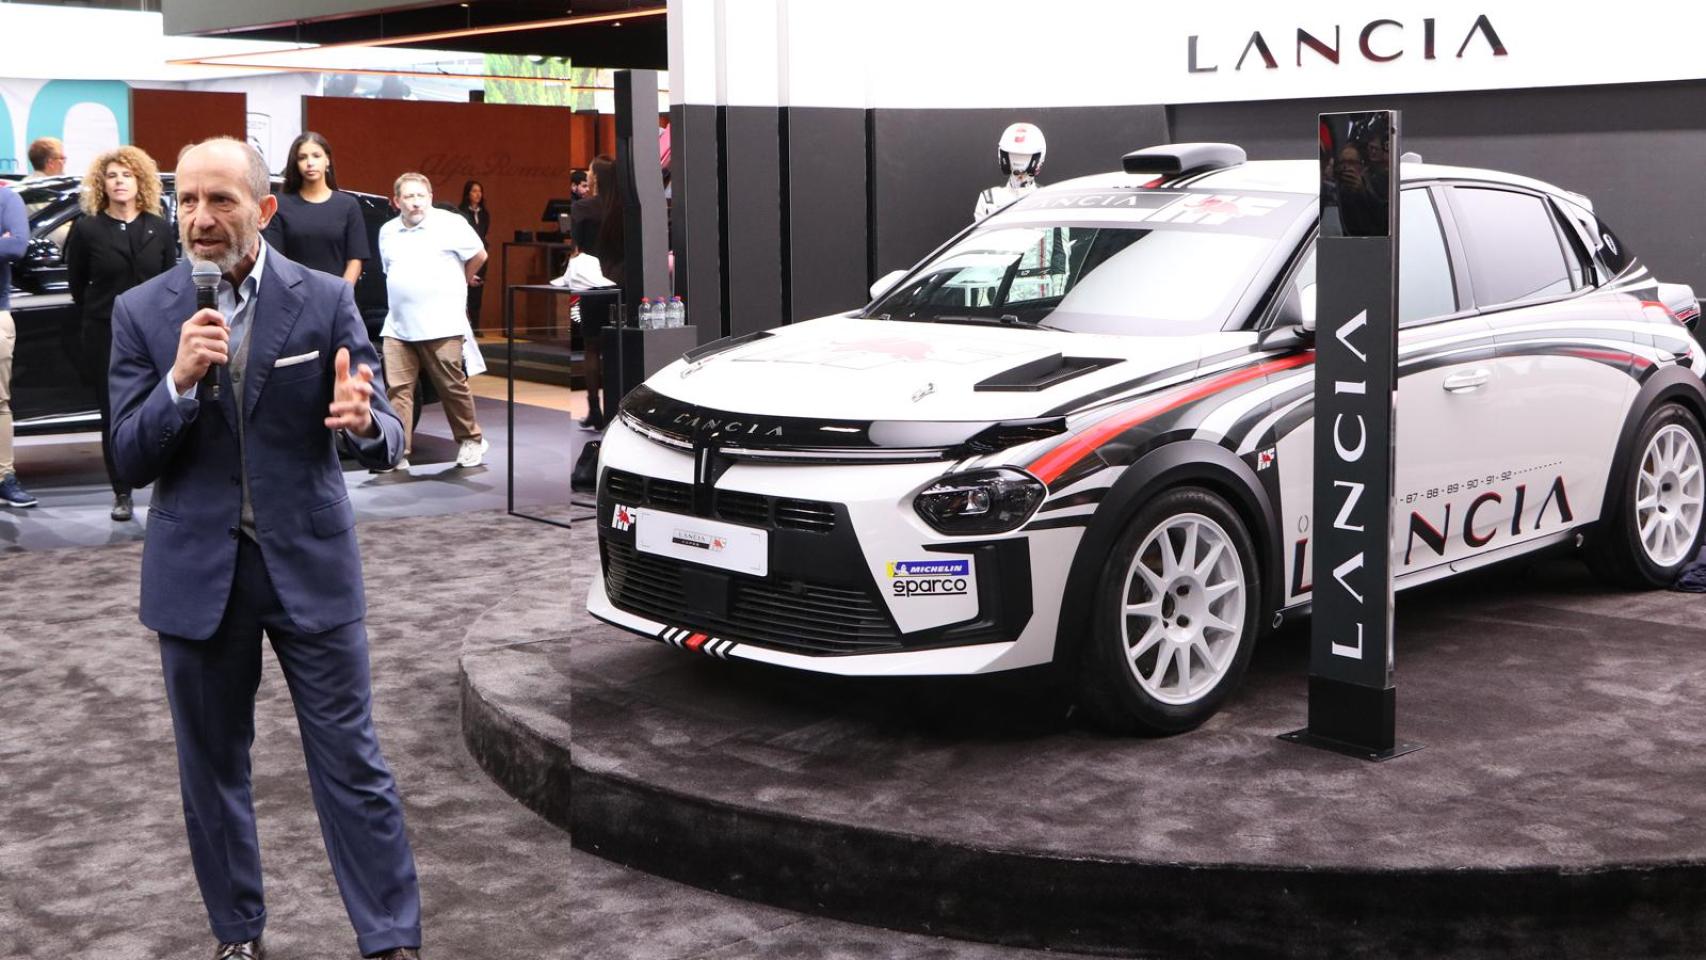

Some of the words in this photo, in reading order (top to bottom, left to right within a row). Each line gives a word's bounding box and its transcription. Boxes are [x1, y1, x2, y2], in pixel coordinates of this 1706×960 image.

[1188, 14, 1508, 73] LANCIA
[1028, 195, 1137, 209] ANCIA
[673, 413, 783, 436] LANCIA
[1331, 309, 1367, 660] LANCIA
[1426, 488, 1439, 499] 88
[1446, 483, 1460, 494] 89
[1466, 479, 1479, 489] 90
[1486, 475, 1495, 486] 91
[1501, 470, 1512, 481] 92
[1291, 475, 1573, 598] LNCIA
[910, 565, 963, 573] MICHELIN
[893, 578, 967, 597] sparco
